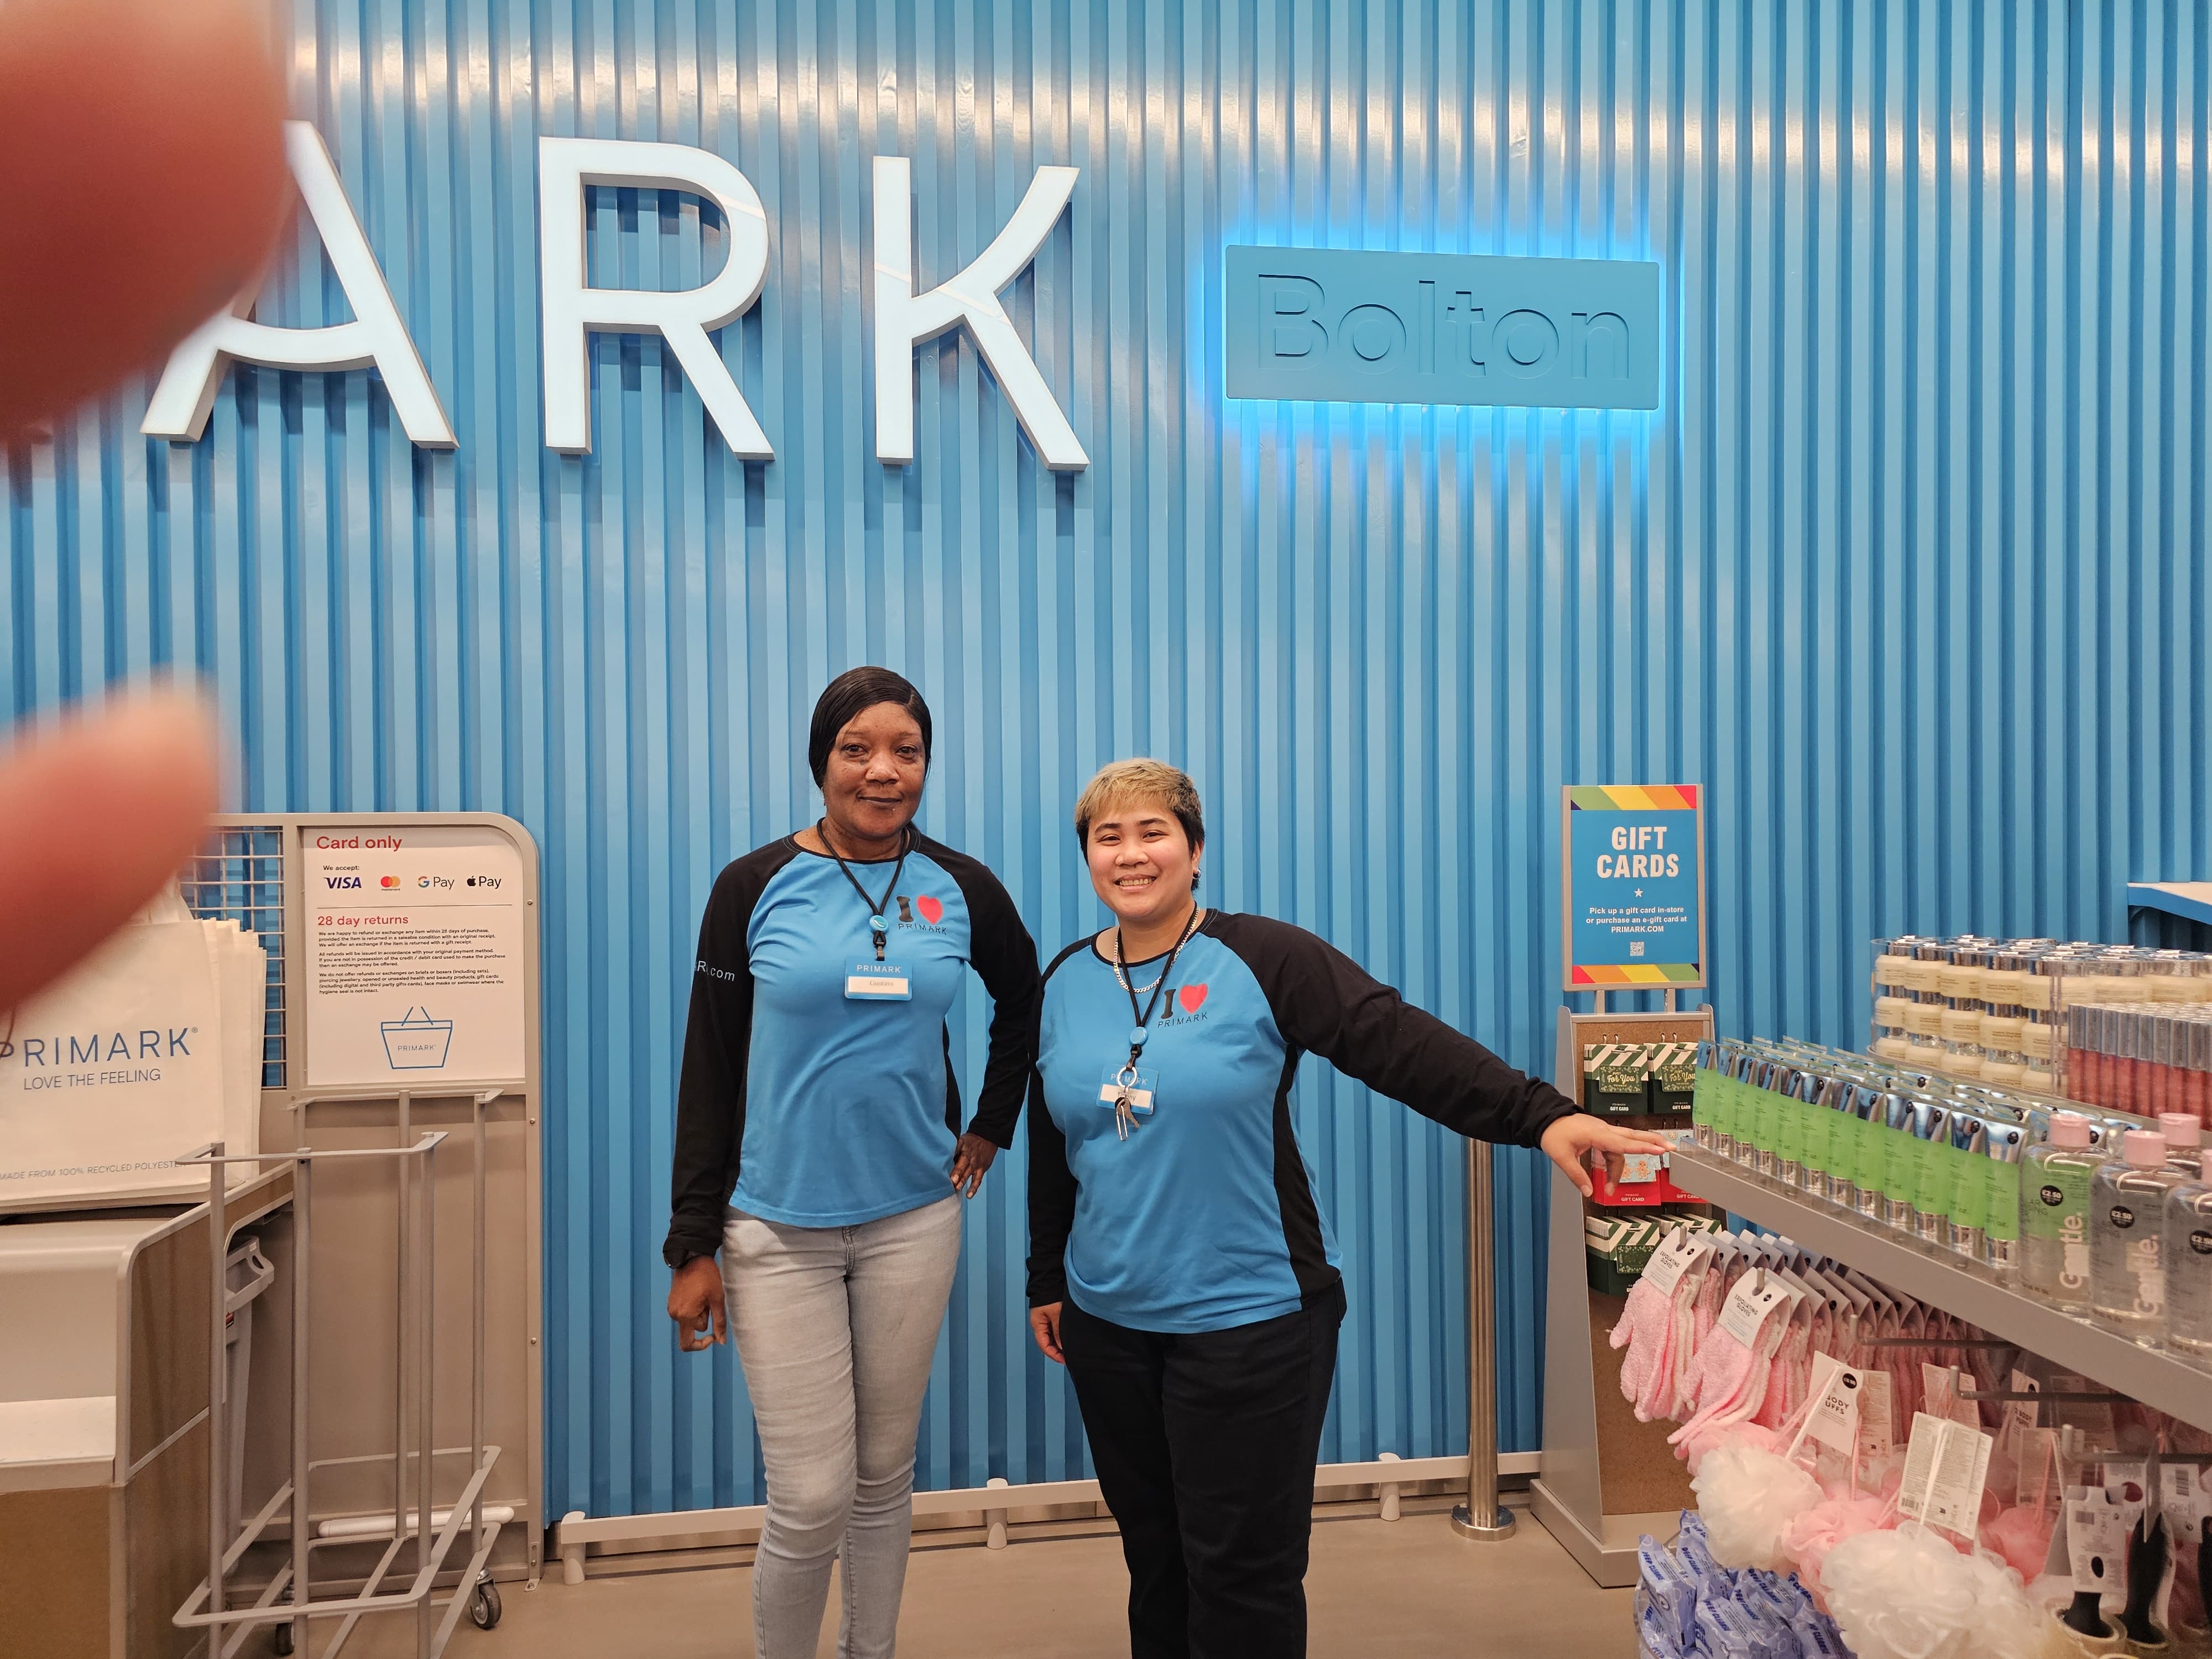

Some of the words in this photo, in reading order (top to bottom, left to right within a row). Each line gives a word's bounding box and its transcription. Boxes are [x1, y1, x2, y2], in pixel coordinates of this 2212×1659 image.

[1258, 273, 1631, 380] Bolton
[316, 836, 359, 849] Card
[365, 836, 403, 852] only
[1611, 826, 1667, 850] GIFT
[1597, 853, 1679, 878] CARDS
[324, 877, 362, 889] VISA
[433, 876, 455, 890] Pay
[478, 875, 502, 889] Pay
[896, 896, 914, 922] I
[317, 916, 332, 926] 28
[337, 916, 360, 927] day
[364, 915, 409, 925] returns
[898, 924, 947, 935] PRIMARK
[857, 964, 901, 973] PRIMARK
[1161, 989, 1176, 1019] I
[1157, 1012, 1208, 1028] PRIMARK
[24, 1076, 62, 1090] LOVE
[67, 1073, 95, 1087] THE
[100, 1068, 161, 1084] FEELING
[1620, 1074, 1635, 1084] You
[0, 1171, 25, 1181] MADE
[28, 1169, 55, 1178] FROM
[59, 1167, 85, 1176] 100%
[87, 1164, 132, 1174] RECYCLED
[1660, 1251, 1680, 1268] EXFOLIATING
[1660, 1258, 1672, 1269] GLOVES
[1734, 1294, 1758, 1316] EXFOLIATING
[1736, 1303, 1751, 1317] GLOVES
